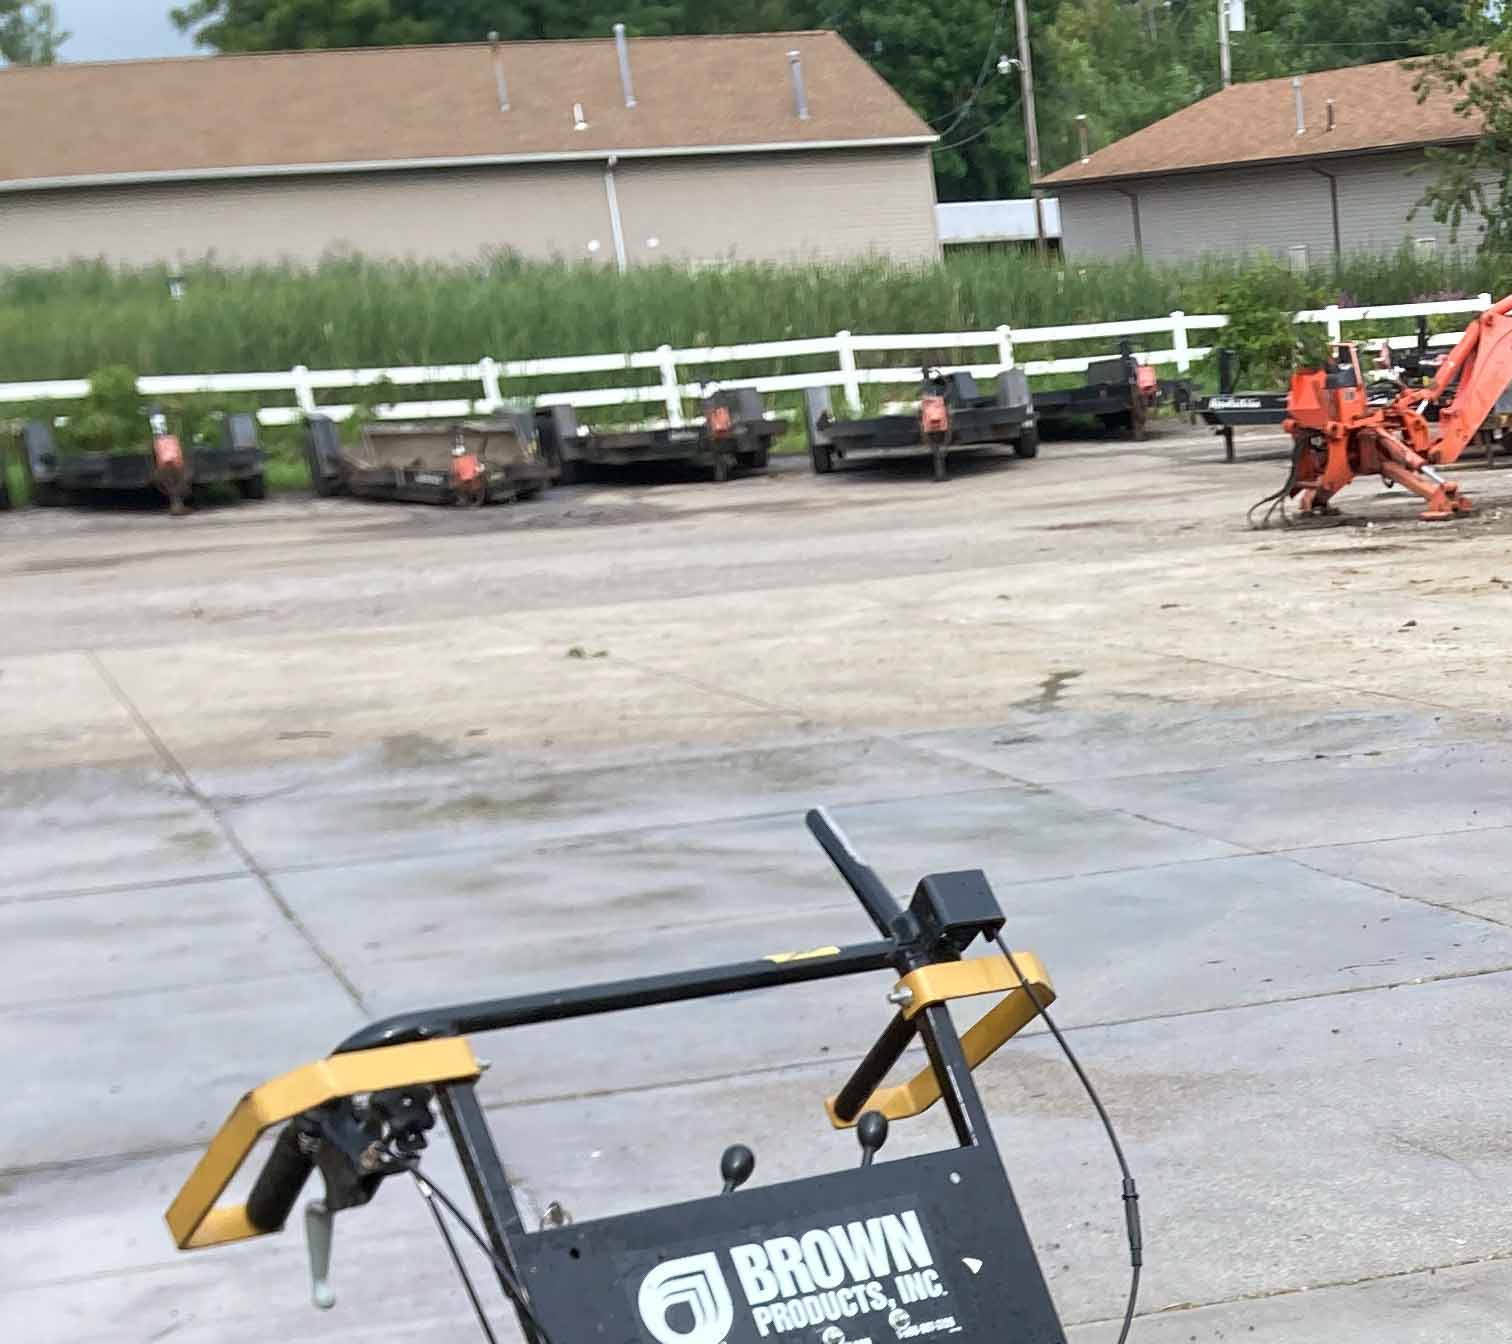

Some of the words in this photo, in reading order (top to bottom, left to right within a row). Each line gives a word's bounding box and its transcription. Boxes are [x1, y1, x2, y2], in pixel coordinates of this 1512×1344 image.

[729, 1209, 934, 1306] BROWN
[752, 1281, 897, 1337] PRODUCTS,
[894, 1268, 949, 1305] INC.
